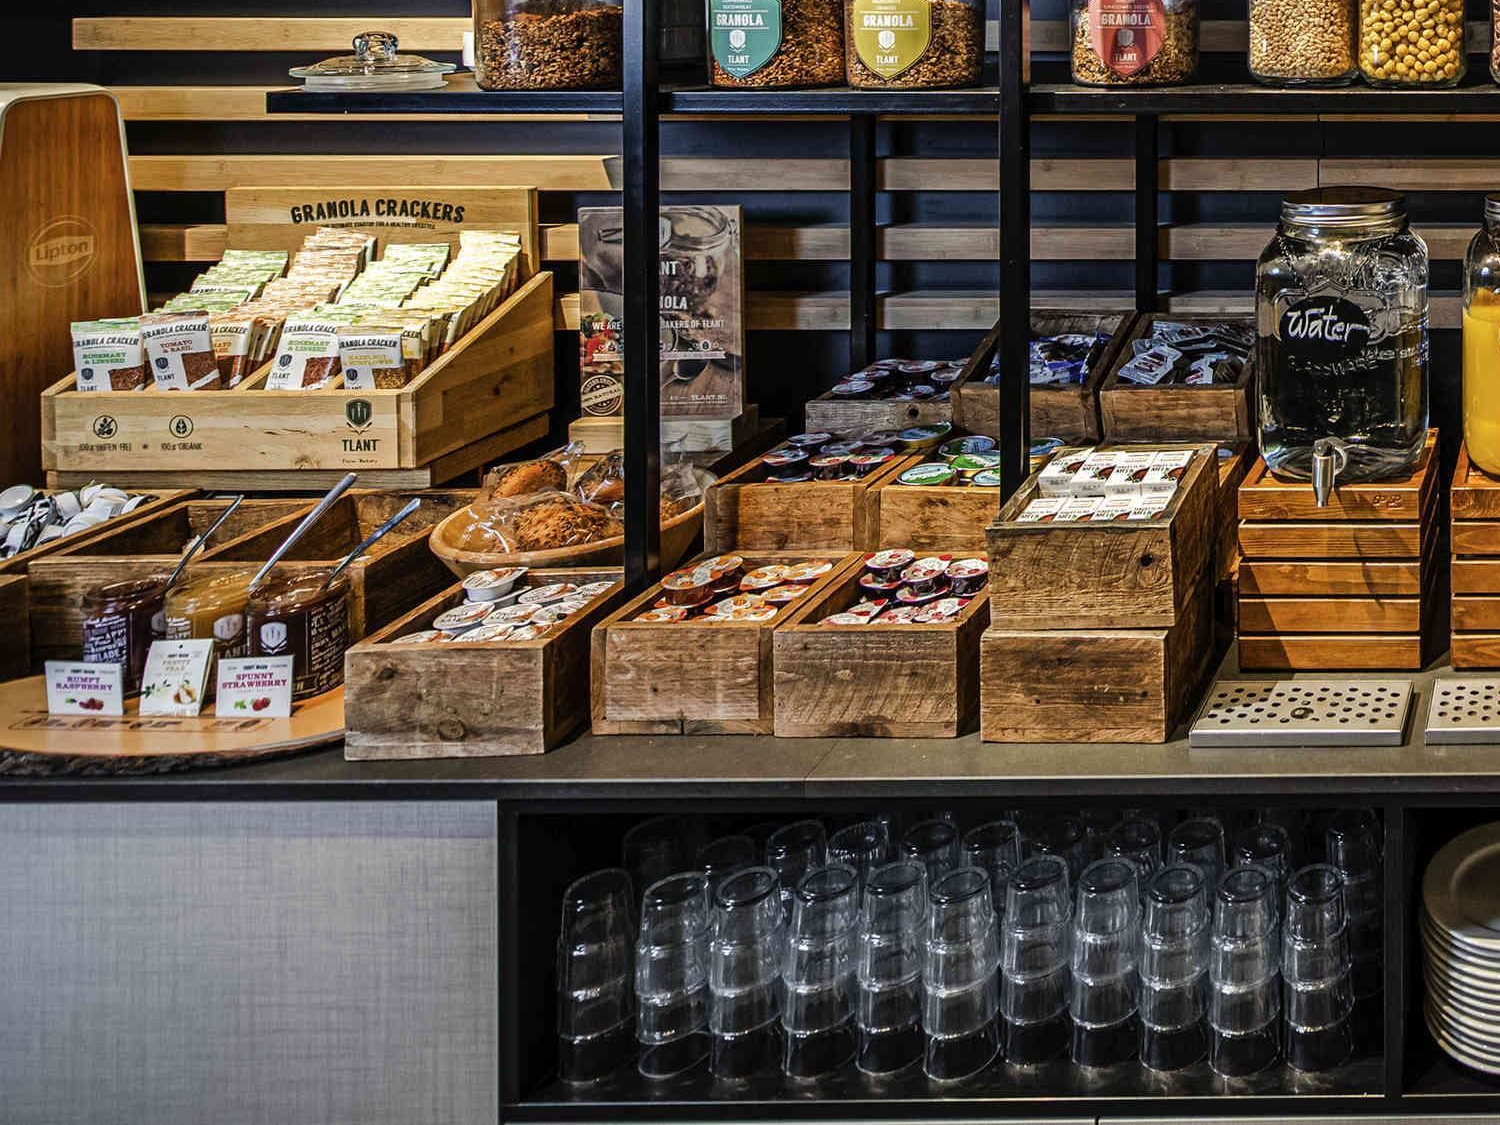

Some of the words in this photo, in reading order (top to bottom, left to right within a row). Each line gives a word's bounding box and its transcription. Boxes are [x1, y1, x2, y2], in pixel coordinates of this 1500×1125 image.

[716, 14, 764, 26] GRANOLA
[863, 14, 914, 28] GRANOLA
[1101, 13, 1151, 26] GRANOLA
[290, 199, 370, 224] GRANOLA
[375, 199, 465, 223] CRACKERS
[36, 241, 88, 261] Lipton
[175, 323, 208, 332] CRACKER
[315, 325, 338, 333] CRACK
[592, 322, 605, 330] WE
[607, 322, 621, 330] ARE
[691, 320, 701, 328] OF
[1286, 304, 1370, 342] Water
[367, 338, 397, 348] CRACKER
[342, 439, 381, 451] TLANT
[56, 683, 113, 691] RASPBERRY
[222, 679, 287, 689] STRAWBERRY
